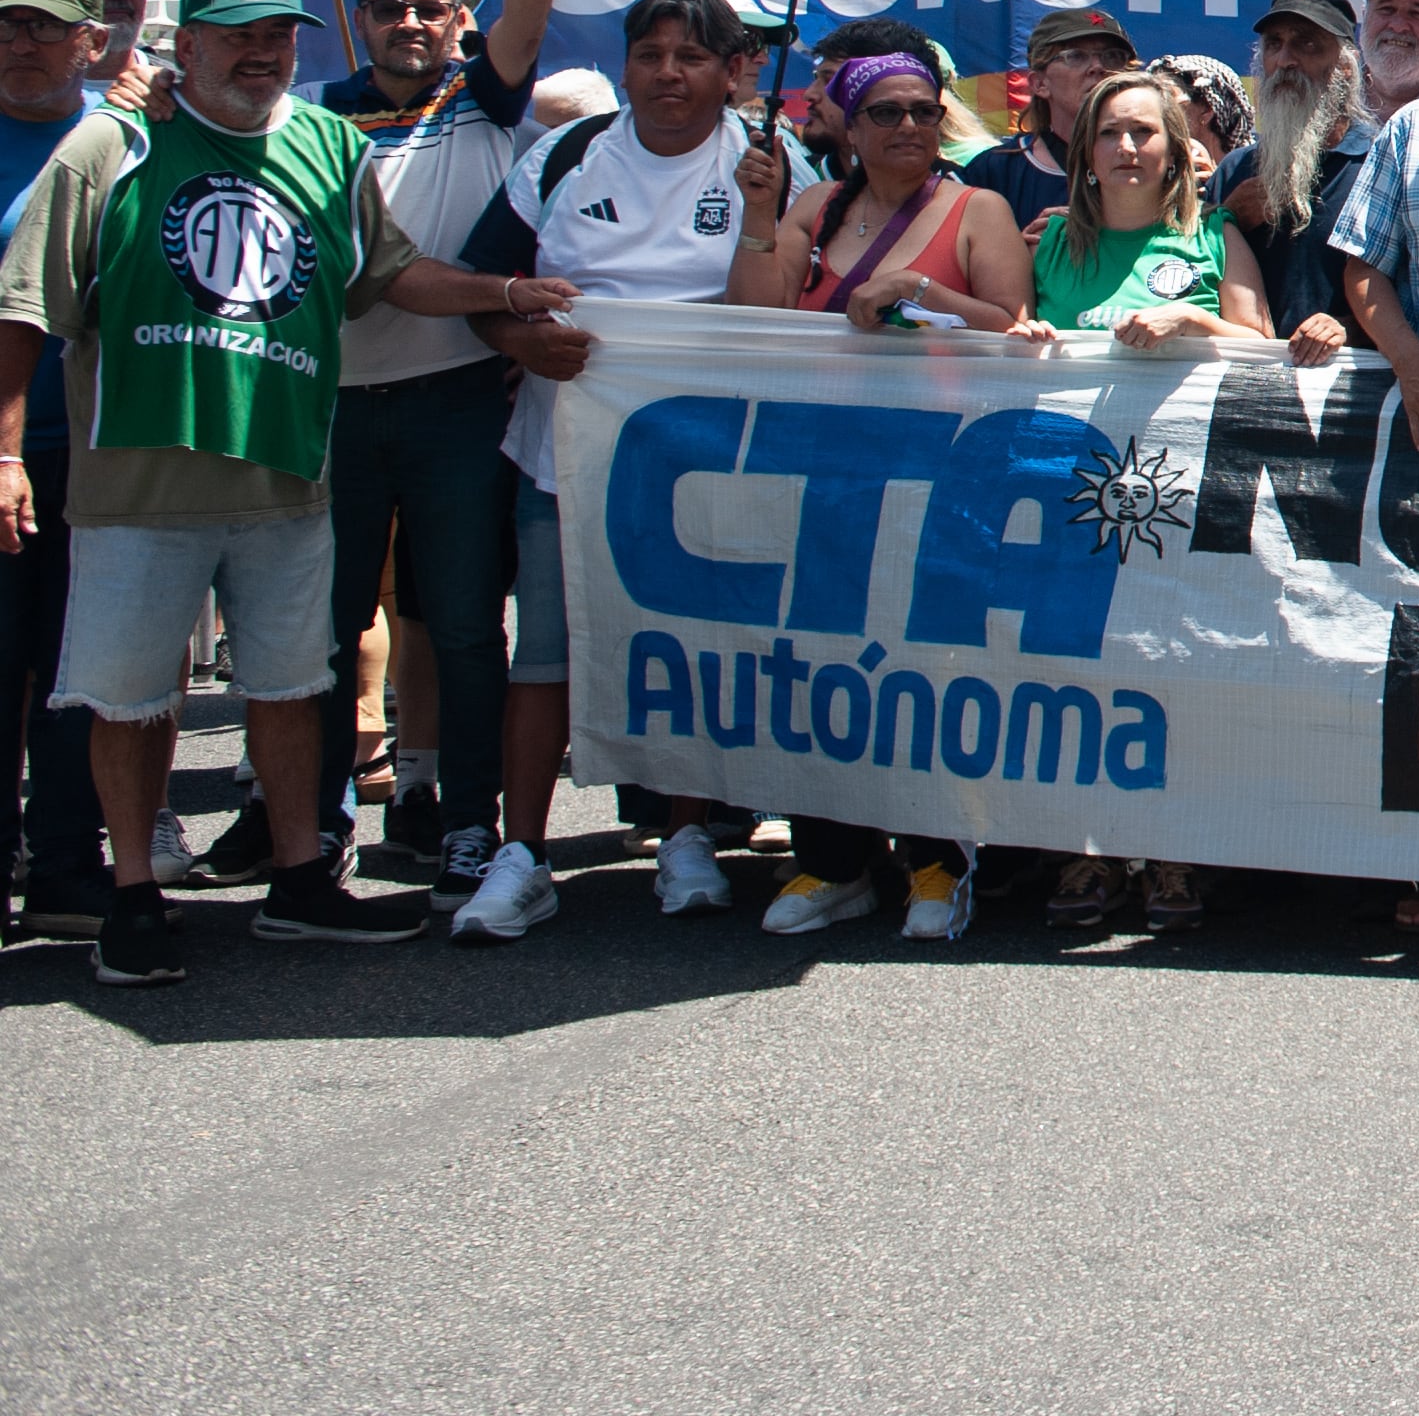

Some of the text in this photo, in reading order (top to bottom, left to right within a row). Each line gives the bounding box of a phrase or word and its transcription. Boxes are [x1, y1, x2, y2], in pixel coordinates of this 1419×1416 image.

[192, 198, 284, 290] ATE
[606, 394, 1122, 659] CTA
[626, 630, 1168, 791] Autónoma
